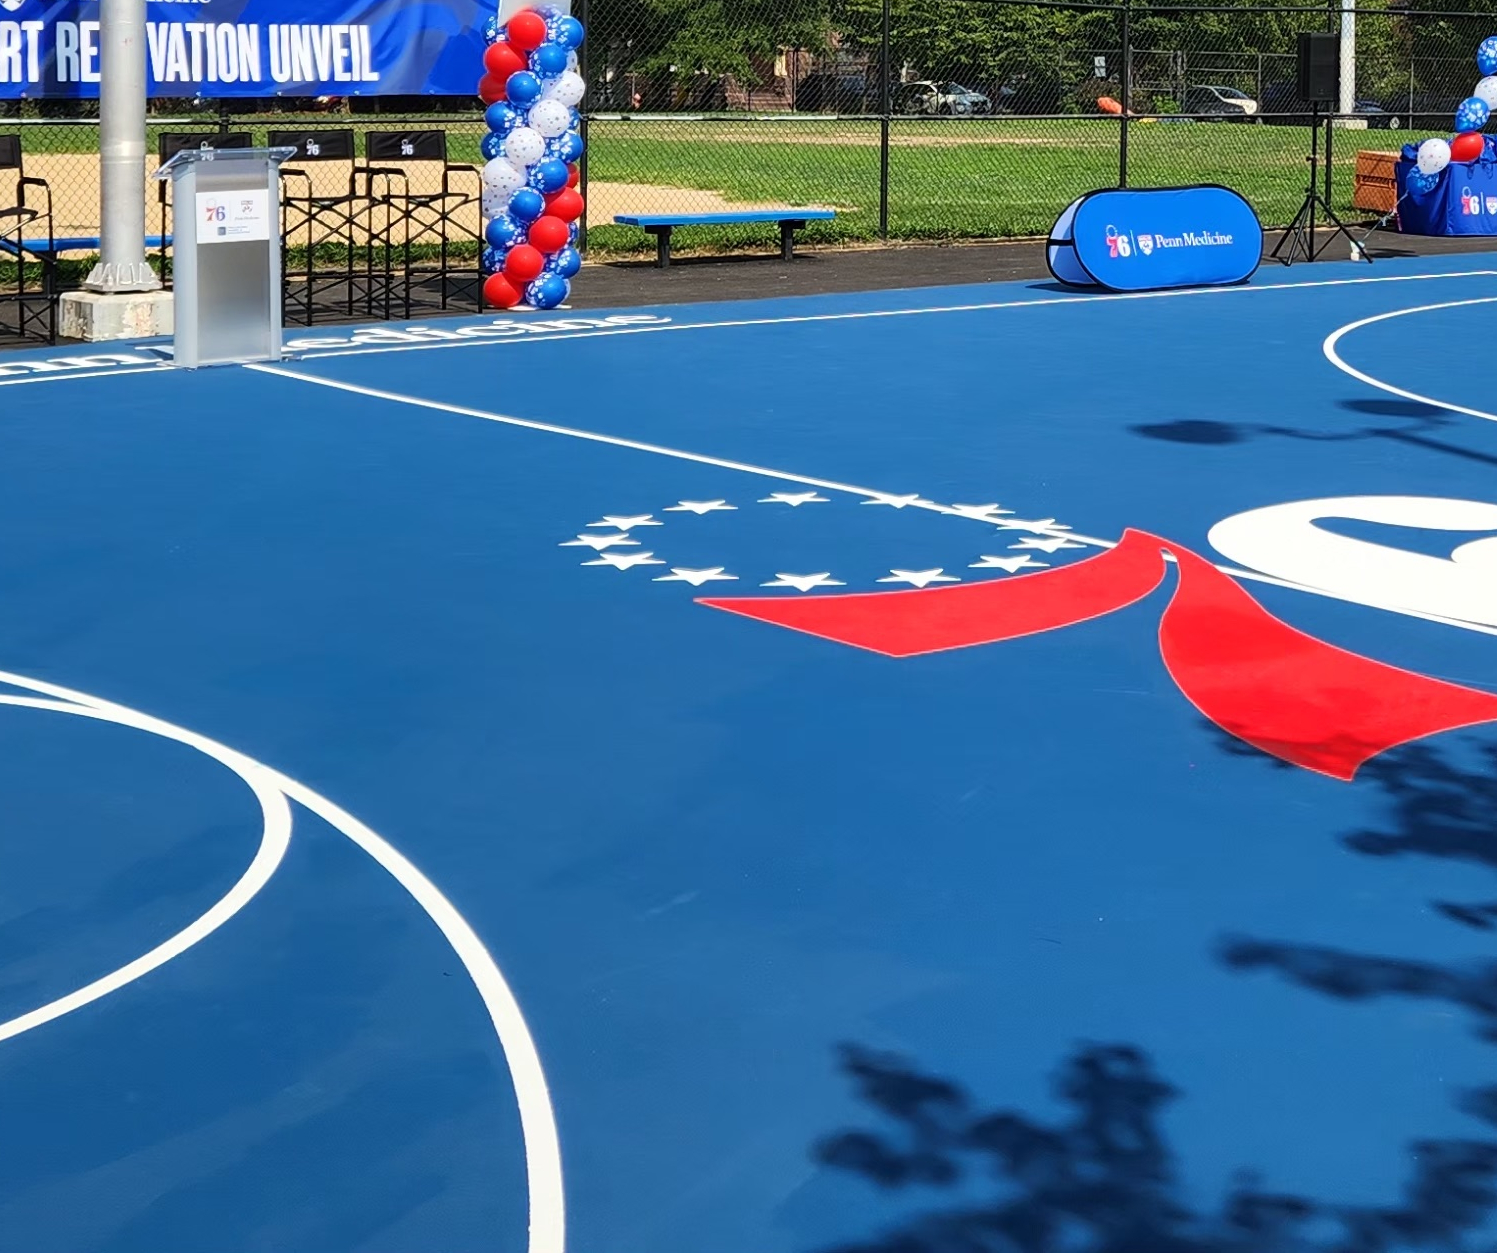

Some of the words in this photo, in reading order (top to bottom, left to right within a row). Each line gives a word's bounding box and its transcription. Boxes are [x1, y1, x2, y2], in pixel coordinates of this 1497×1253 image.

[55, 21, 262, 83] REVATION
[268, 24, 380, 82] UNVEIL
[306, 145, 320, 156] 76
[401, 144, 414, 156] 76
[205, 206, 226, 222] 76
[1461, 196, 1480, 215] 76
[1106, 235, 1131, 258] 76
[1155, 234, 1184, 249] Penn
[1182, 230, 1233, 247] Medicine
